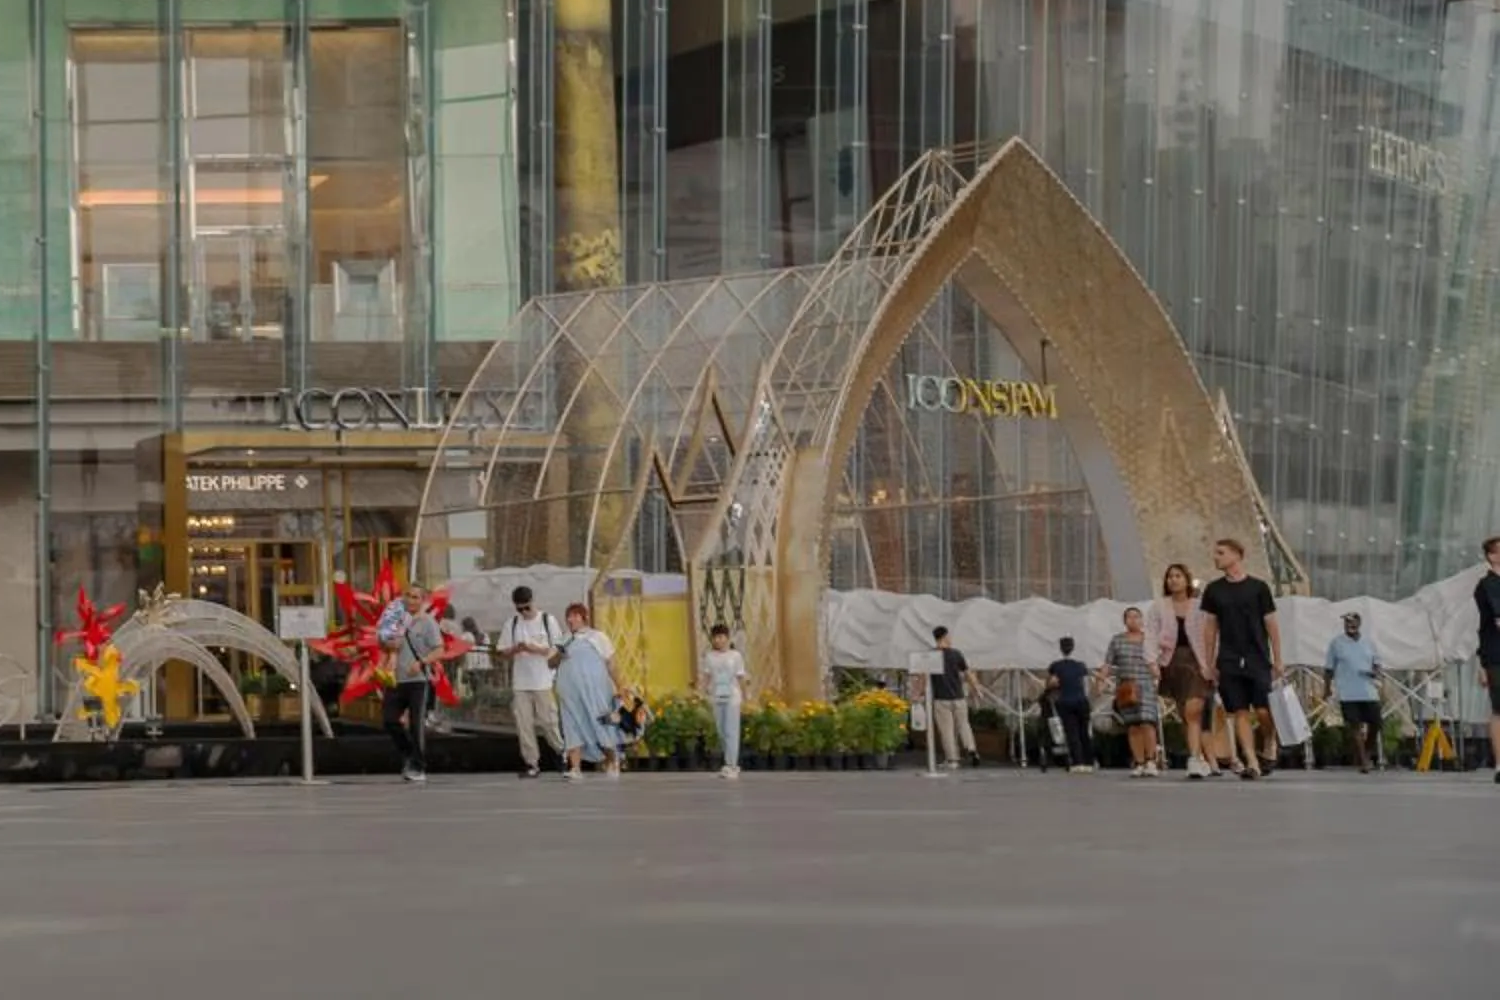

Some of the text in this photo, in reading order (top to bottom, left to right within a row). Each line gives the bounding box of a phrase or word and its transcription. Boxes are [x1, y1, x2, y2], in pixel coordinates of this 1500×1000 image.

[905, 373, 1059, 420] ICONSIAM
[184, 474, 285, 491] ATEK PHILIPPE
